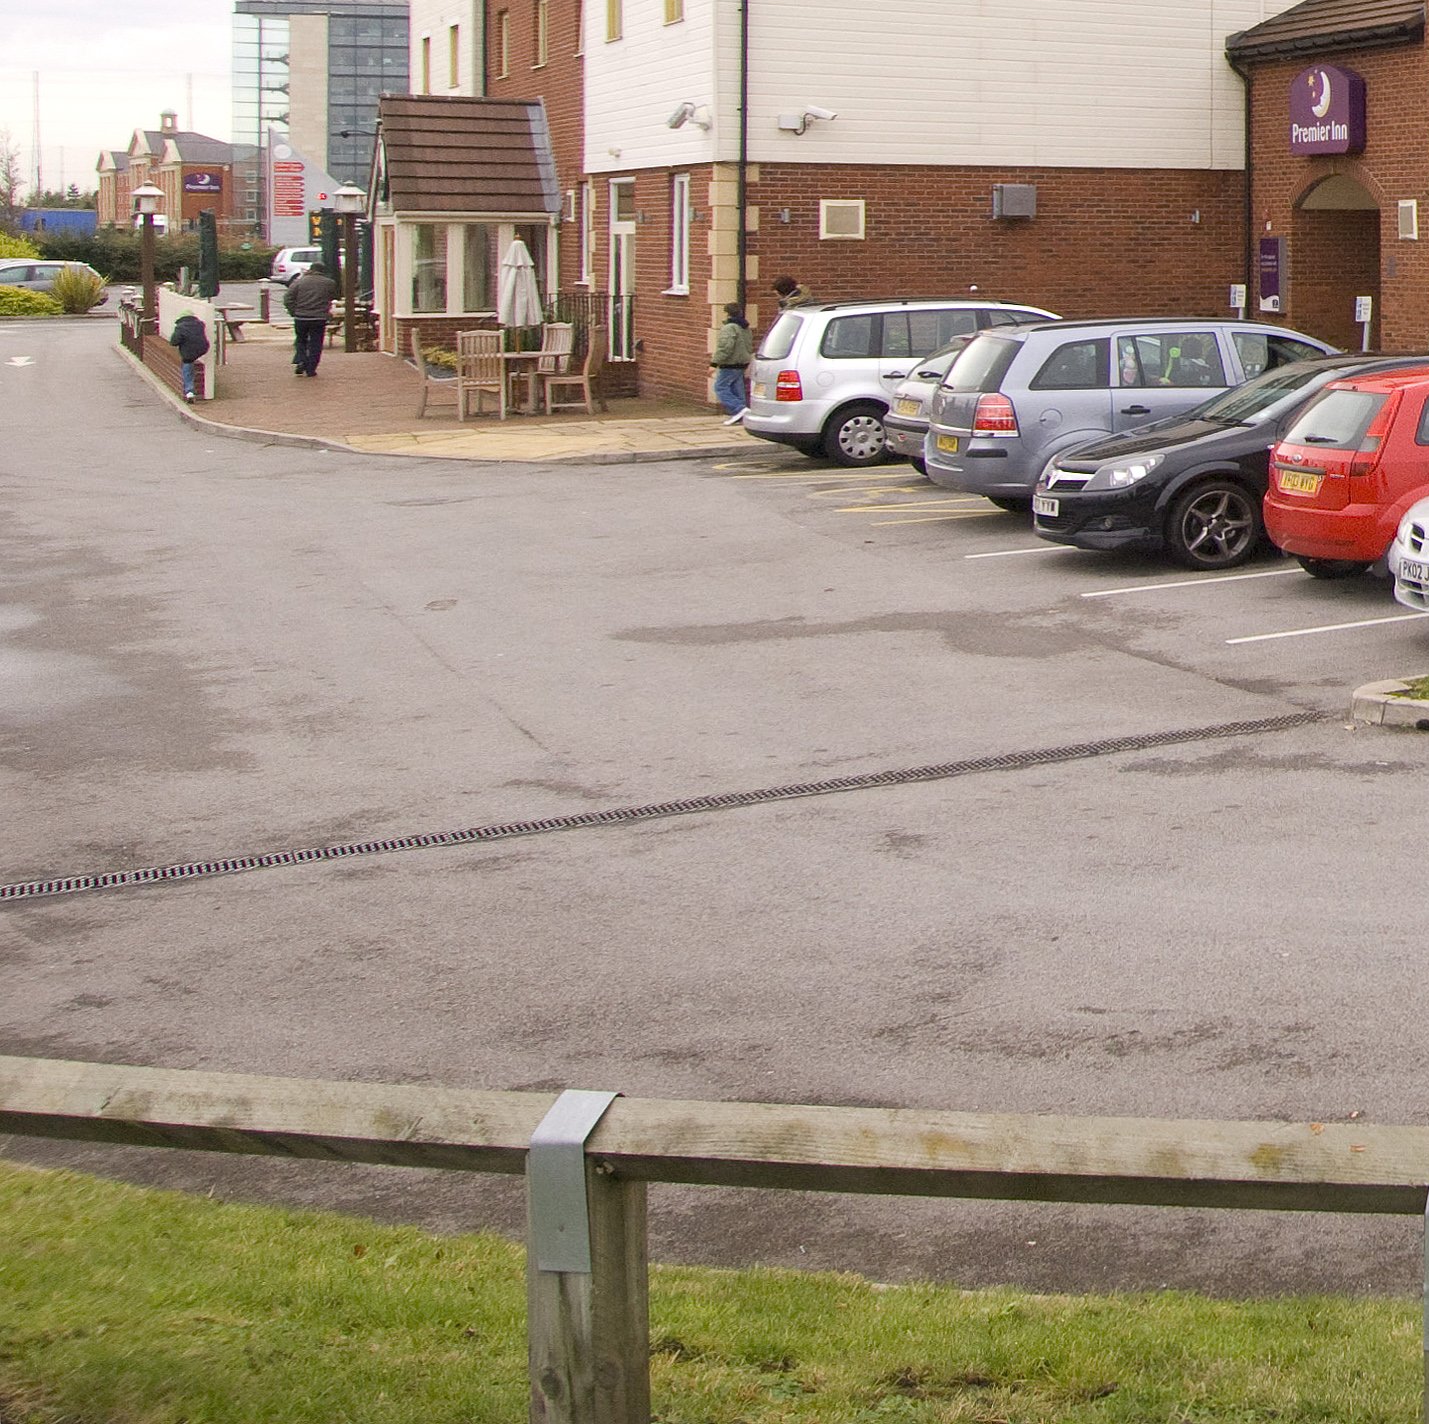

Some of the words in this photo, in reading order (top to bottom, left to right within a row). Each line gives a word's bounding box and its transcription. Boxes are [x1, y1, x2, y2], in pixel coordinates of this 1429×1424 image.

[1292, 121, 1331, 144] Premier
[1331, 120, 1348, 140] Inn
[1403, 560, 1423, 580] PK02
